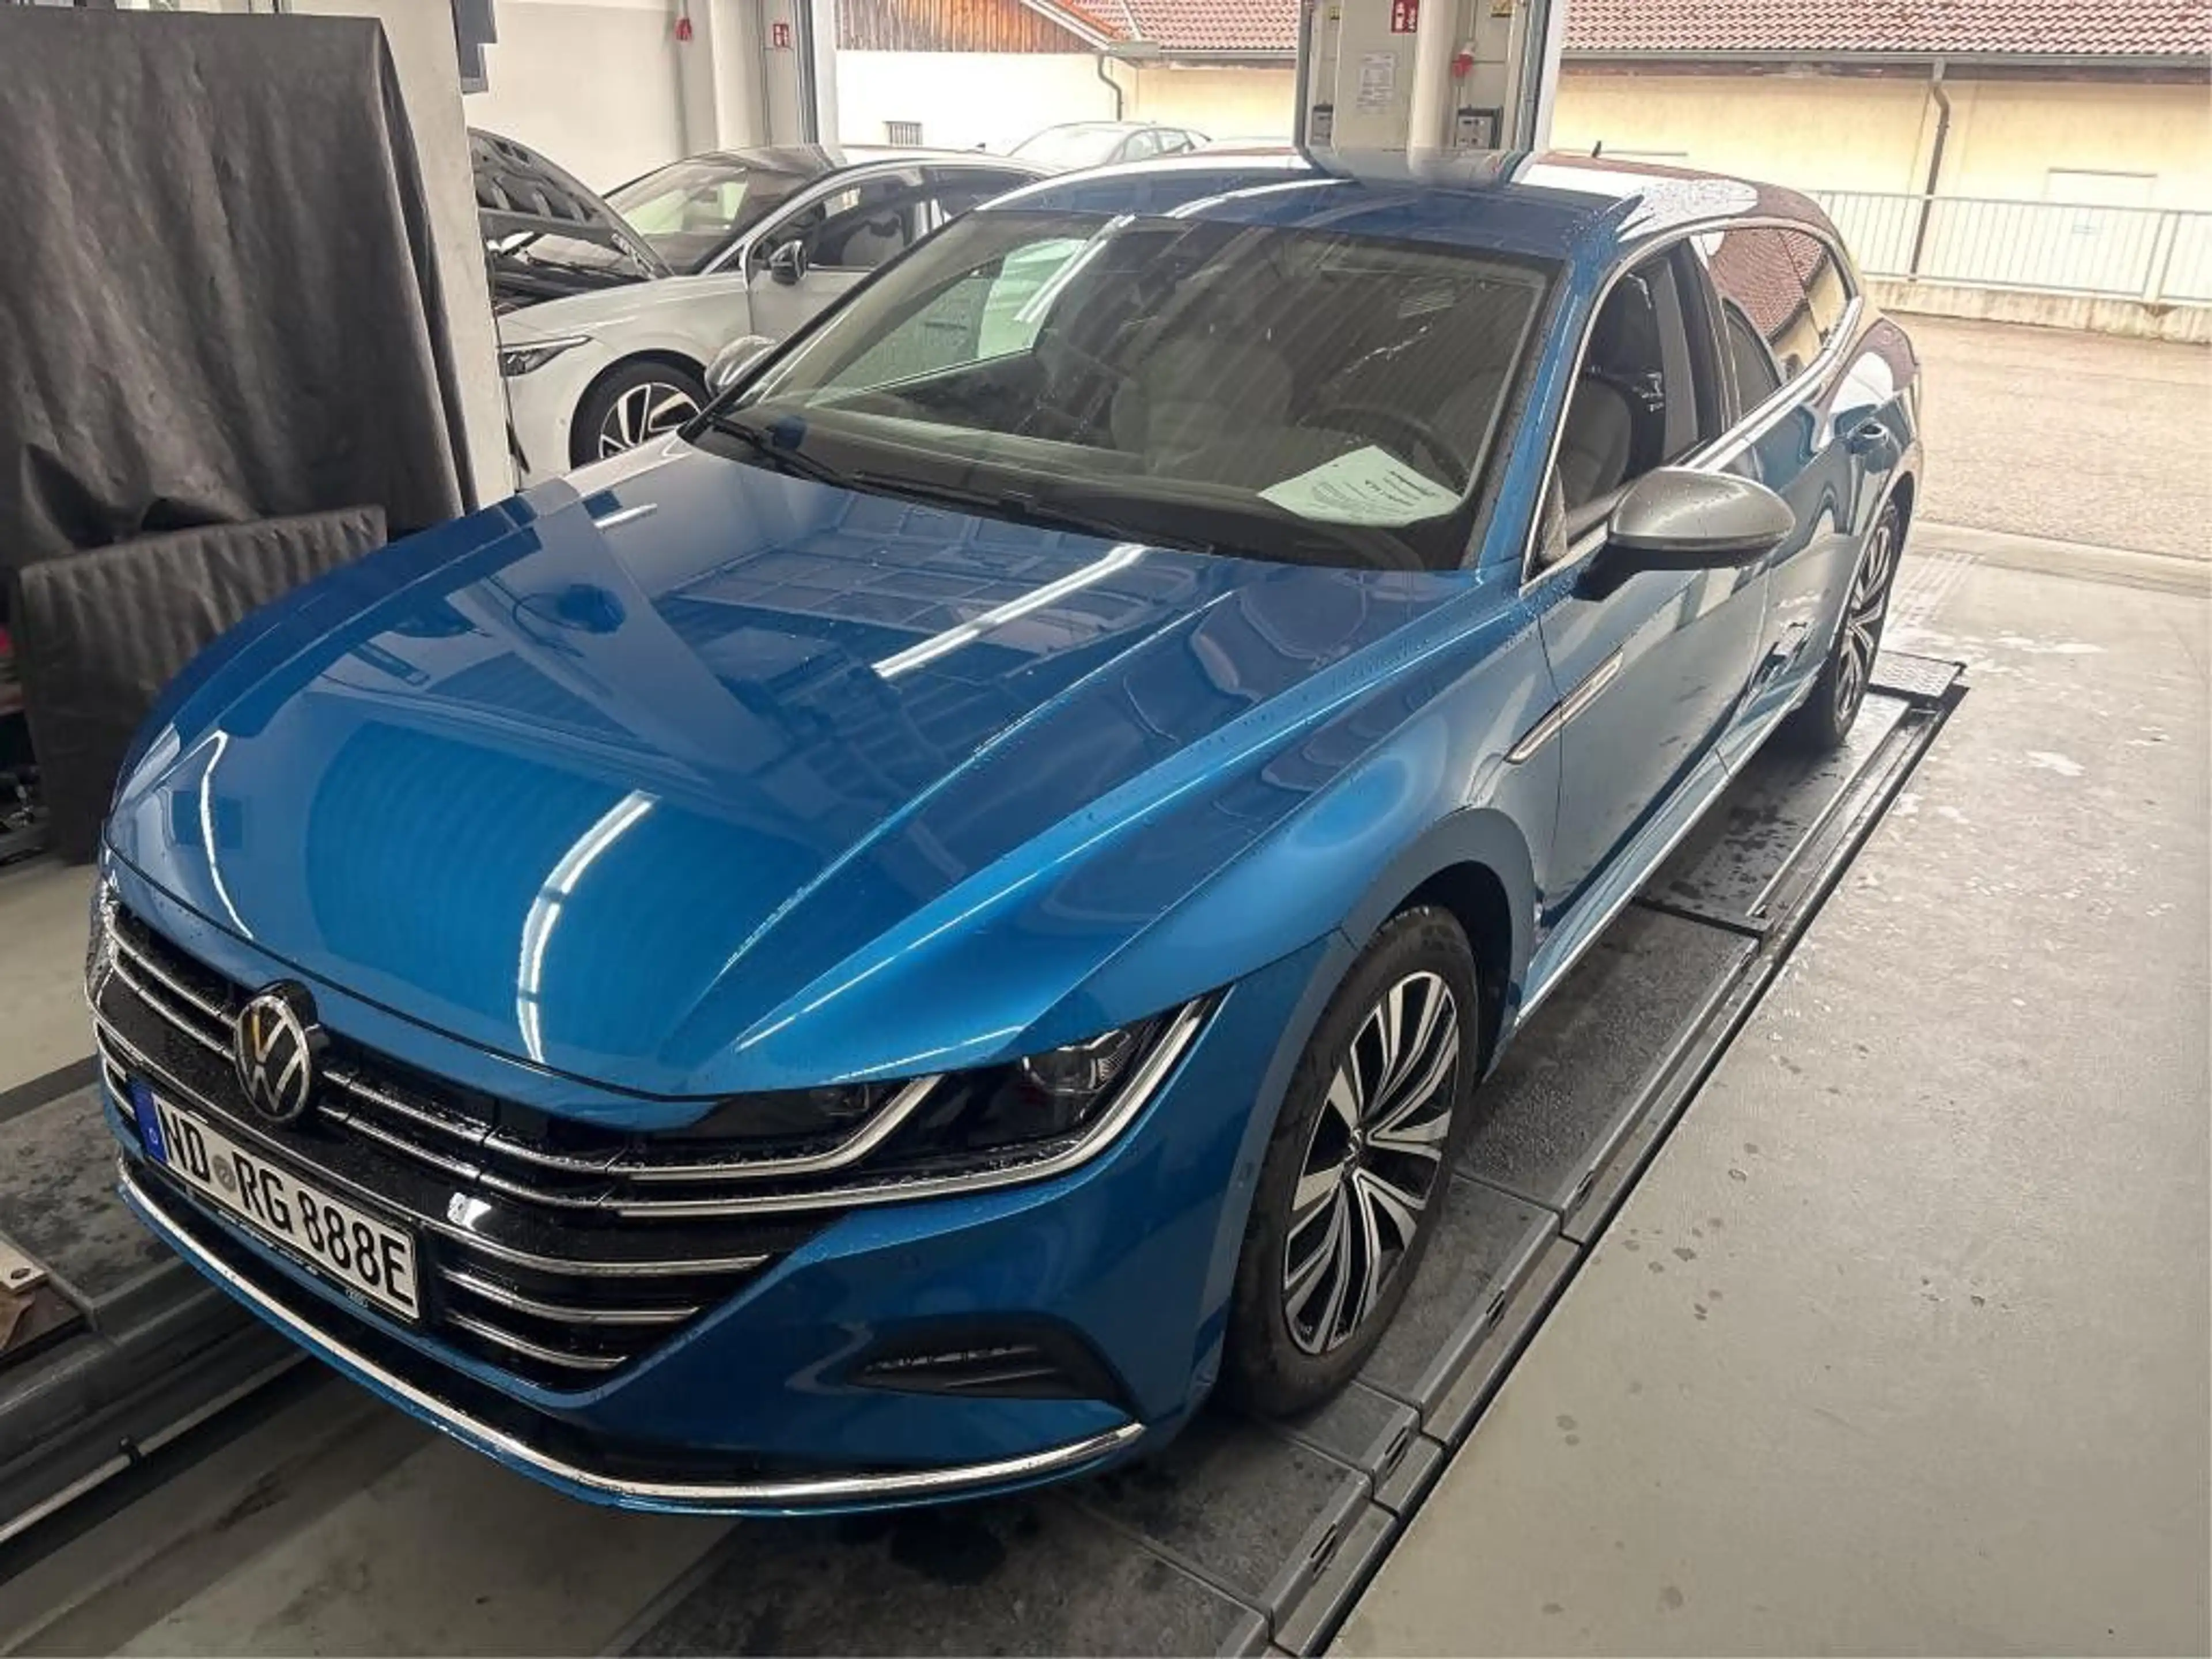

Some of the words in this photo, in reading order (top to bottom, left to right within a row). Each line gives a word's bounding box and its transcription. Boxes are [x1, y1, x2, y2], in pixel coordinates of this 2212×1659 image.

[236, 1001, 308, 1116] VW
[157, 1104, 210, 1183] ND
[232, 1151, 293, 1234] RG
[297, 1190, 414, 1306] 888E
